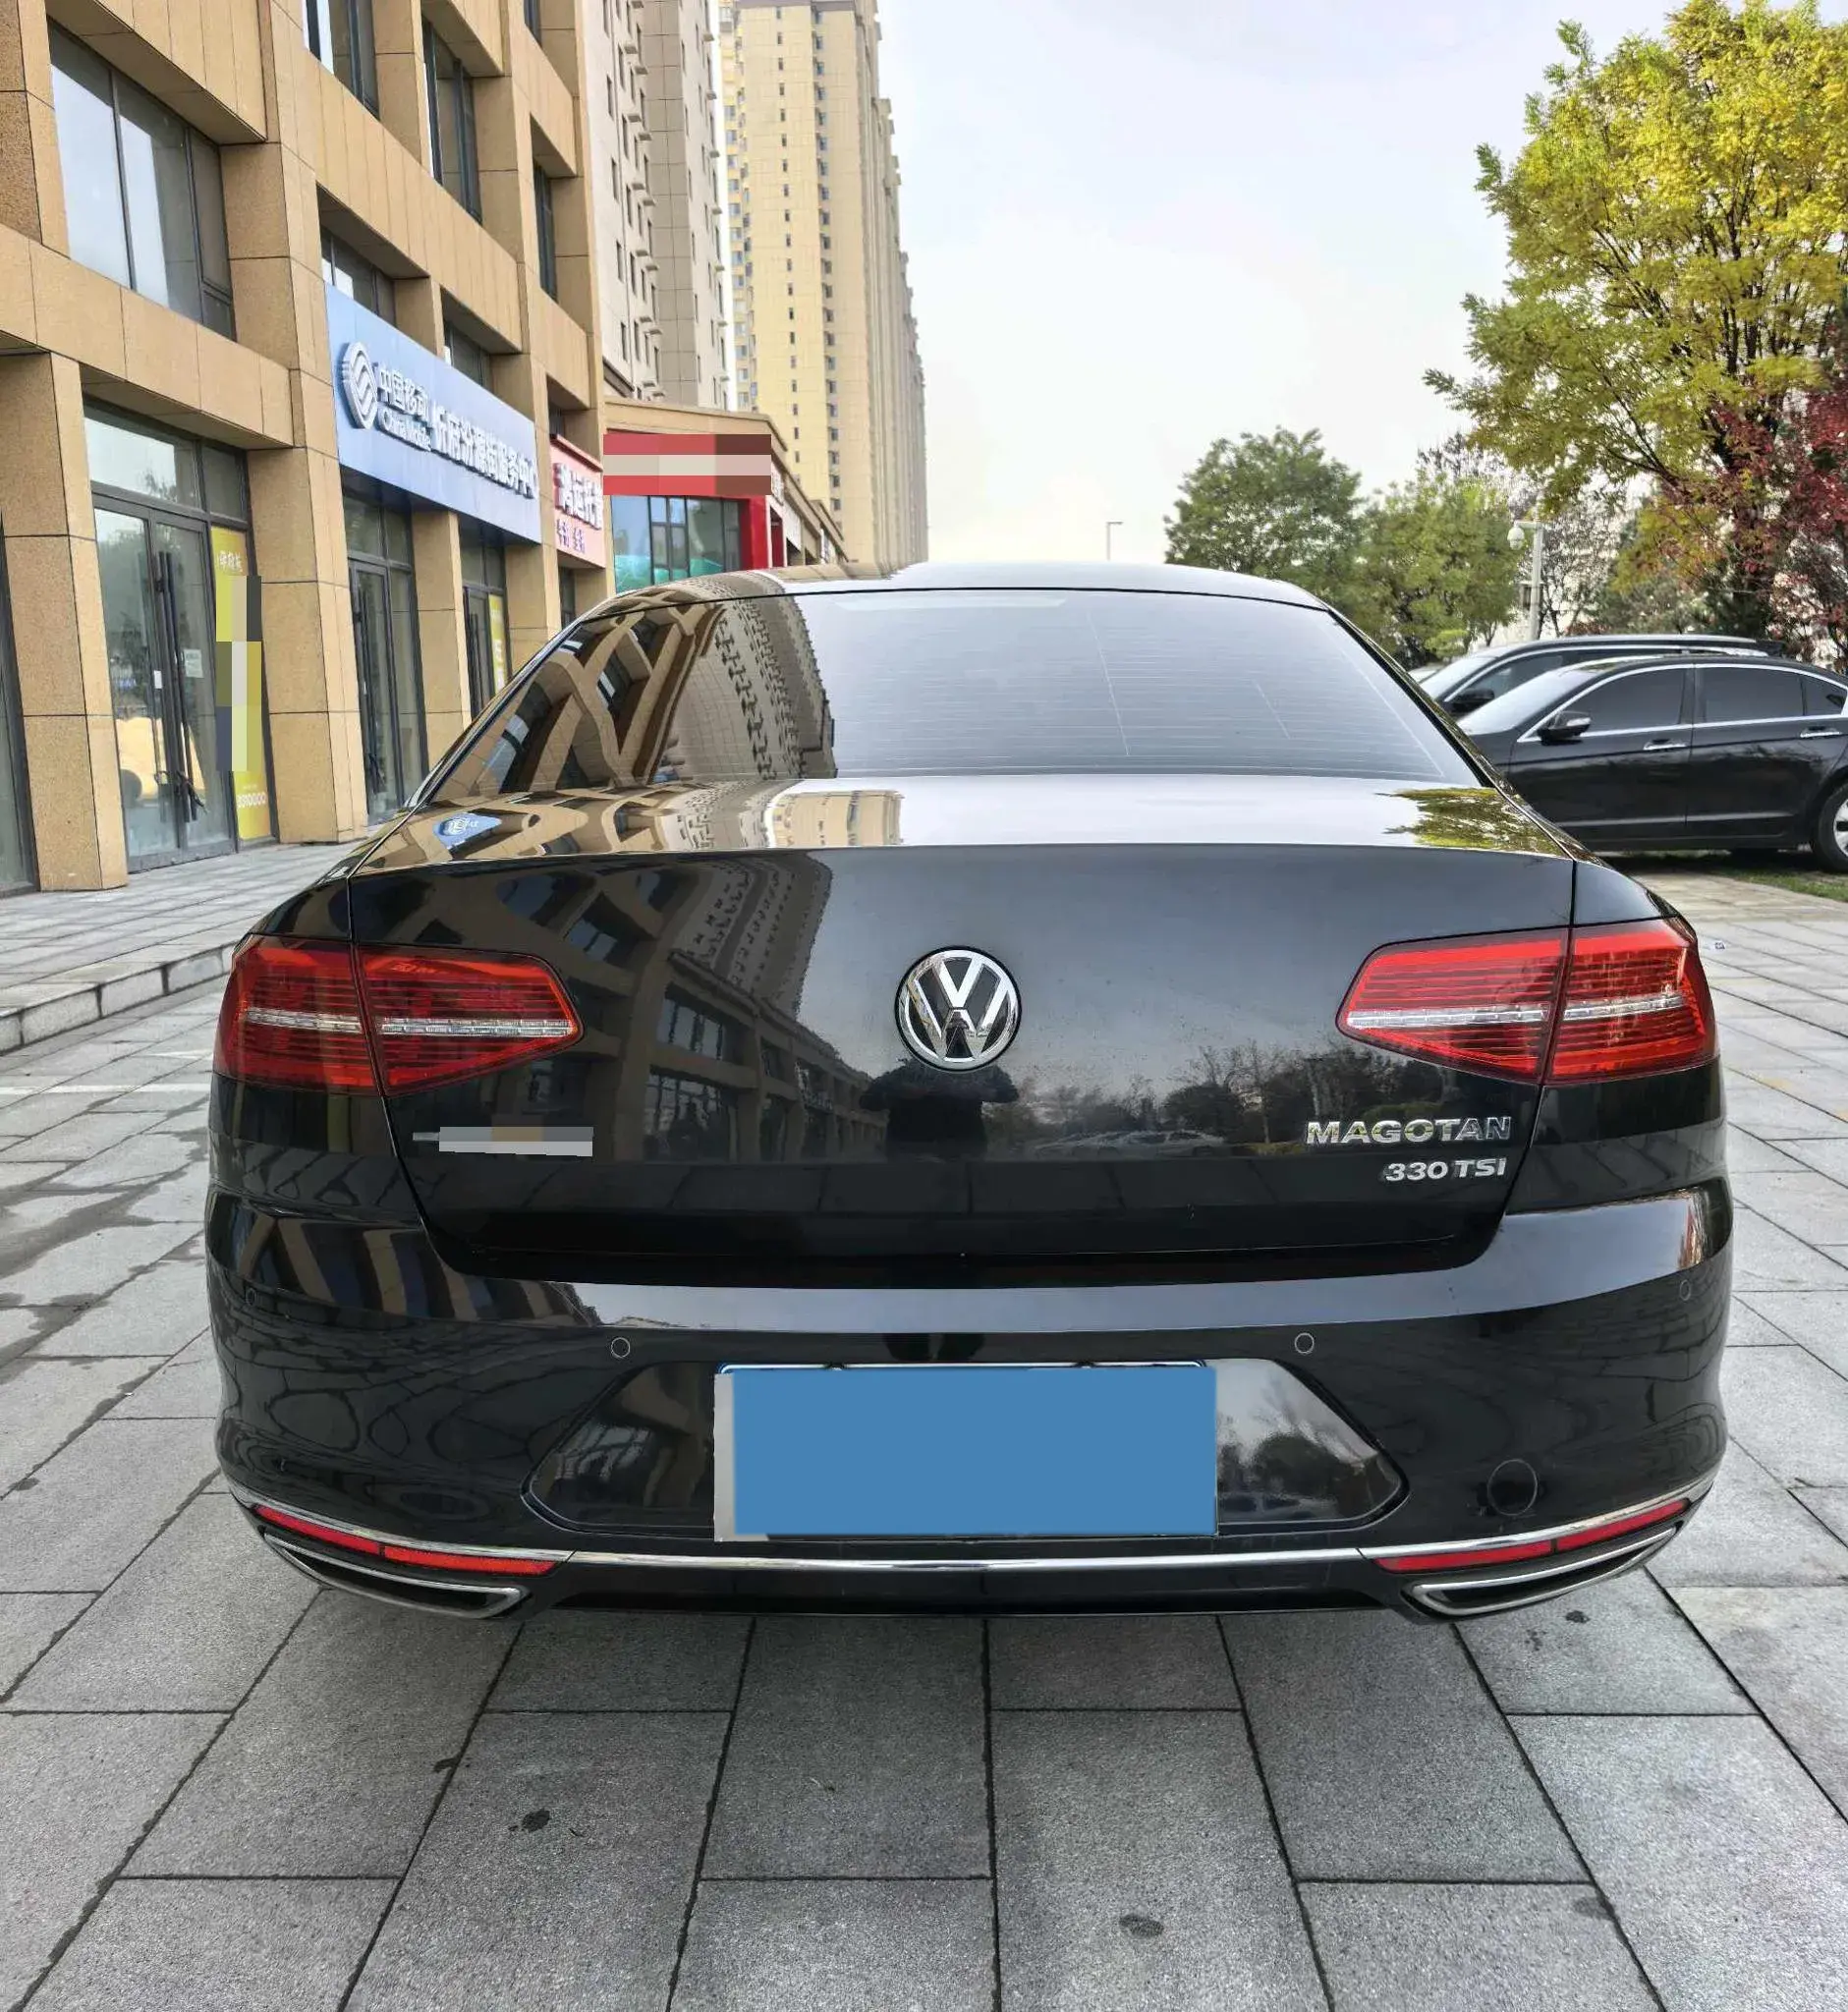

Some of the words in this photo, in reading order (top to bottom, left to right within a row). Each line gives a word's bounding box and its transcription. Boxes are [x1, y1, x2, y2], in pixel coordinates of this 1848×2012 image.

[378, 364, 428, 421] 中国移动
[1306, 1116, 1512, 1145] MAGOTAN
[1384, 1160, 1449, 1182] 330
[1454, 1157, 1507, 1179] TSI
